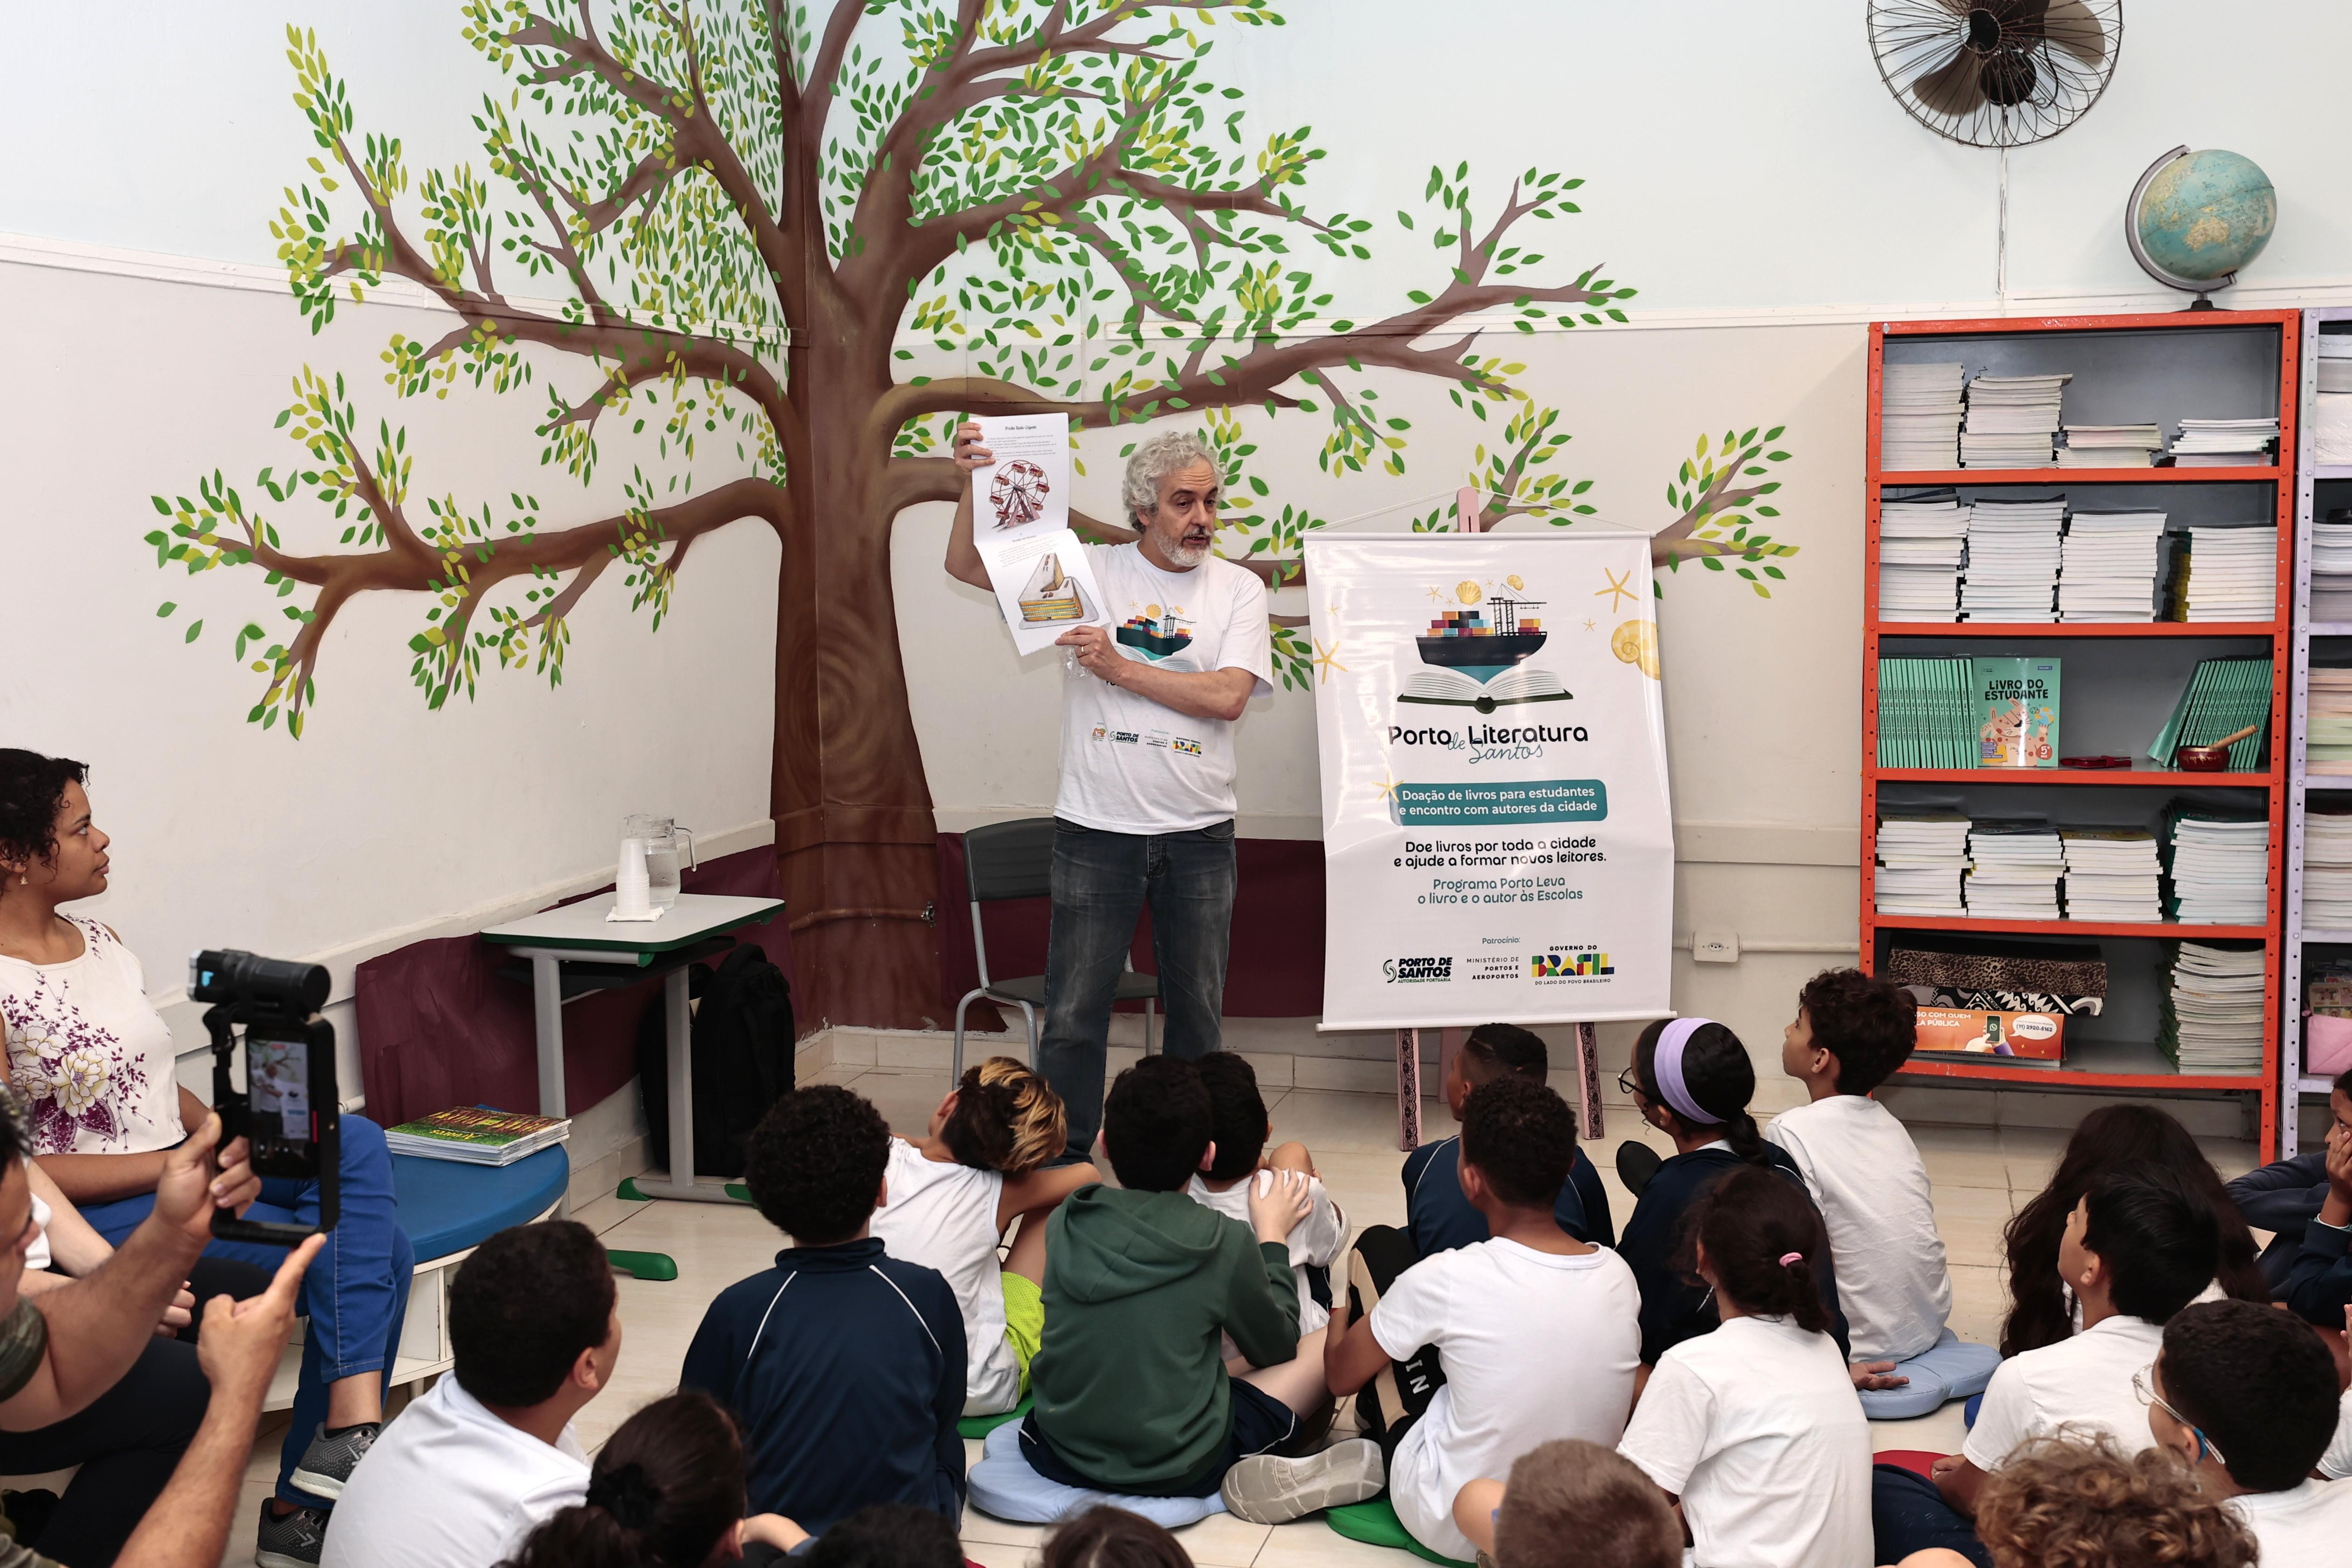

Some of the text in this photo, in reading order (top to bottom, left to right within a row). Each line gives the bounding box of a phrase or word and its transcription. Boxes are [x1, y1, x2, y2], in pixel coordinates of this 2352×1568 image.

[2027, 679, 2044, 689] DO
[1985, 689, 2048, 700] ESTUDANTE
[1388, 723, 1588, 745] Porto Literatura
[1448, 732, 1466, 750] de
[1173, 740, 1202, 755] BRASIL
[1469, 737, 1543, 764] Santos
[1403, 787, 1595, 803] Doação de livros para estudantes
[1409, 806, 1461, 815] encontro
[1464, 806, 1489, 815] com
[1492, 804, 1536, 814] autores
[1540, 802, 1554, 812] da
[1558, 801, 1597, 811] cidade
[1406, 836, 1596, 854] Doe livros por toda a cidade
[1394, 851, 1607, 870] e ajude a formar novos leitores.
[1433, 876, 1565, 892] Programa Porto Leva
[1418, 888, 1583, 904] o livro e o autor às Escolas
[1399, 957, 1453, 967] PORTO DE
[1532, 953, 1615, 977] BRASIL
[1398, 966, 1451, 978] SANTOS
[1927, 1018, 1960, 1027] PÚBLICA
